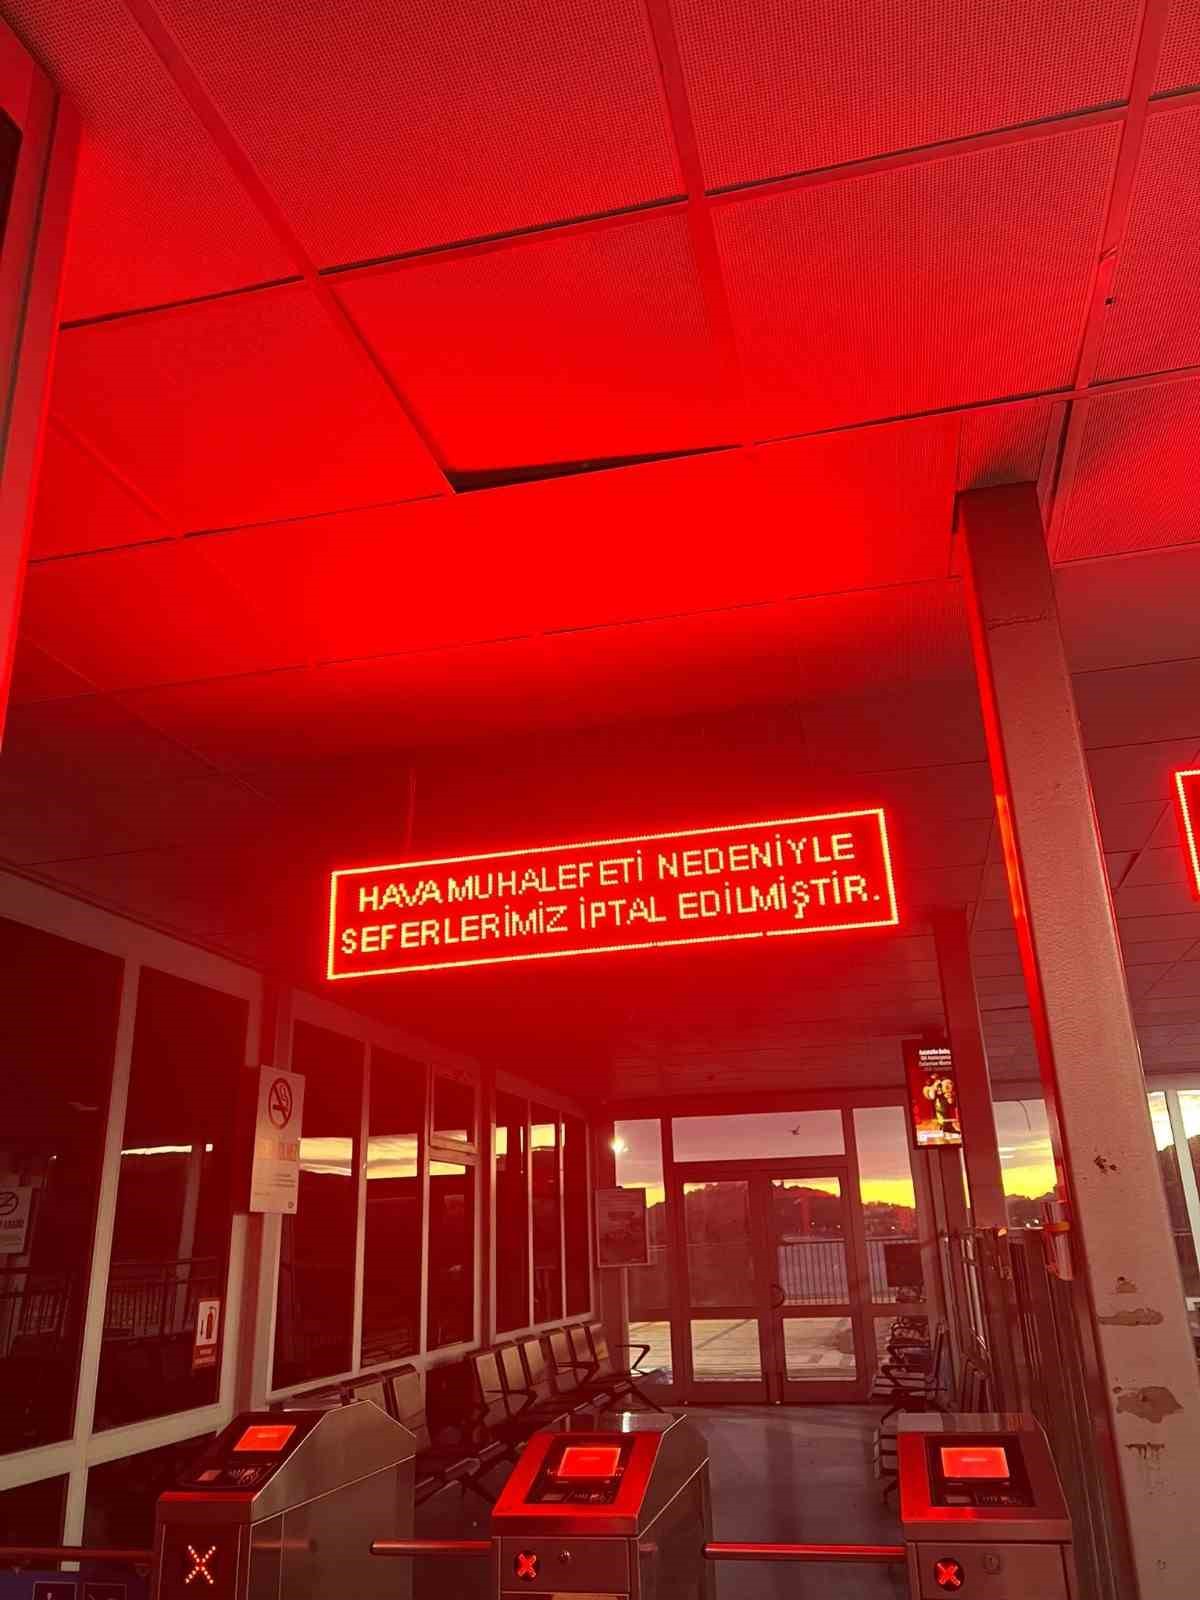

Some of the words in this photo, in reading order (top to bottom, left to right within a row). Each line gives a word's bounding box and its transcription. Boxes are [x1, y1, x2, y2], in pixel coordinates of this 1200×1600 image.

[341, 901, 569, 955] SEFERLERİMİZ
[579, 896, 667, 929] İPTAL
[678, 871, 880, 920] EDİLMİŞTİR.
[359, 880, 443, 912] HAVA
[447, 850, 644, 902] MUHALEFETİ
[658, 833, 855, 880] NEDENİYLE
